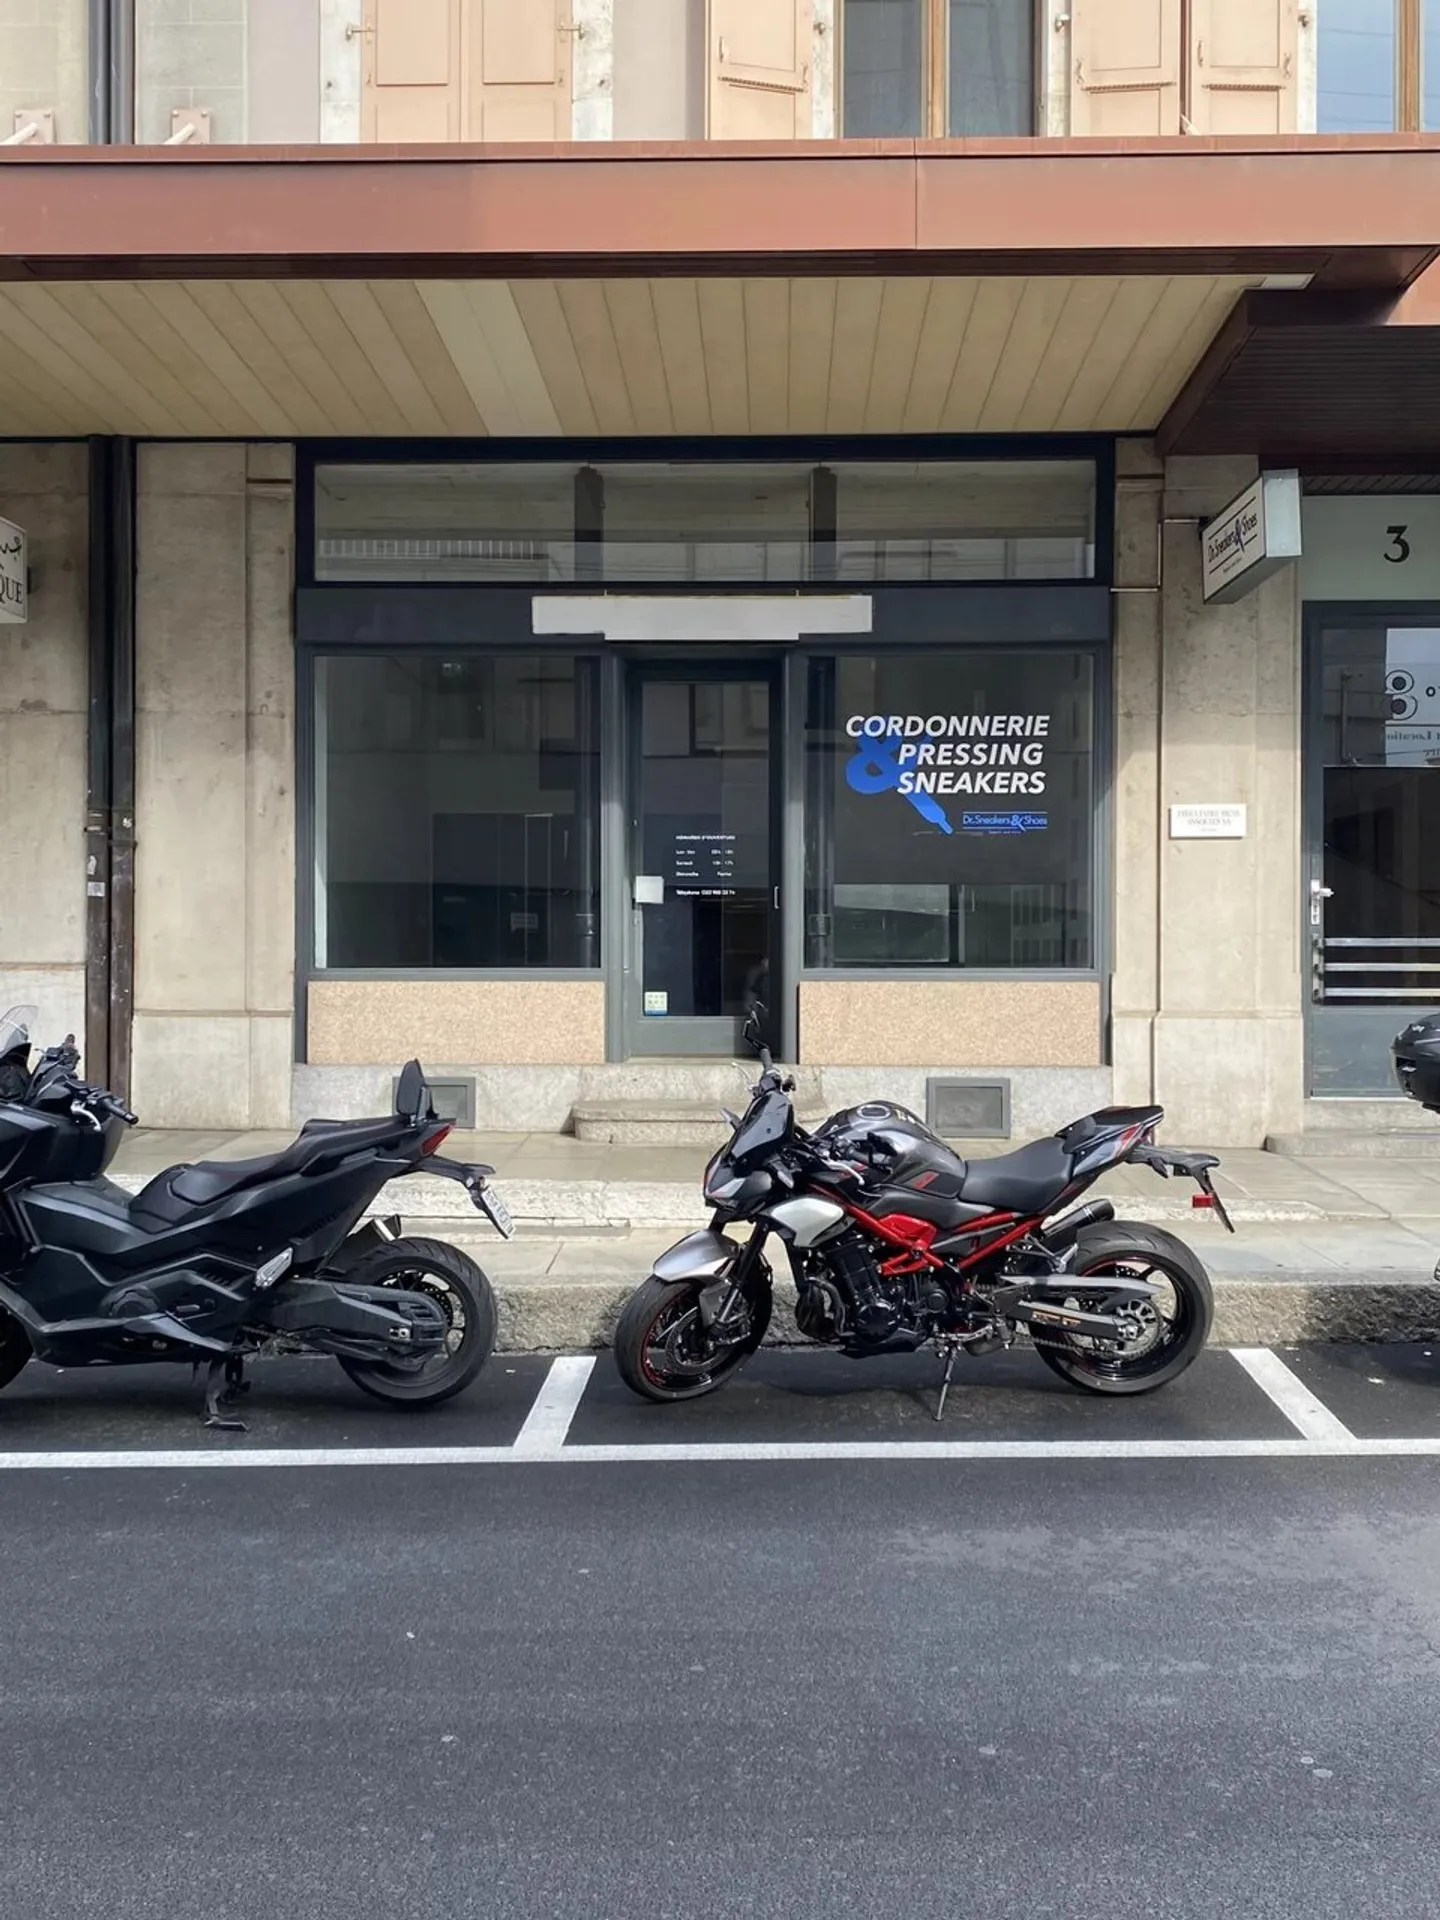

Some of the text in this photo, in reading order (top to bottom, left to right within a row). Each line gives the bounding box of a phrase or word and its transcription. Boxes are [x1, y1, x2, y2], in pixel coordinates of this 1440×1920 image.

[1383, 525, 1410, 563] 3
[846, 715, 1050, 737] CORDONNERIE
[898, 743, 1044, 766] PRESSING
[897, 771, 1046, 794] SNEAKERS
